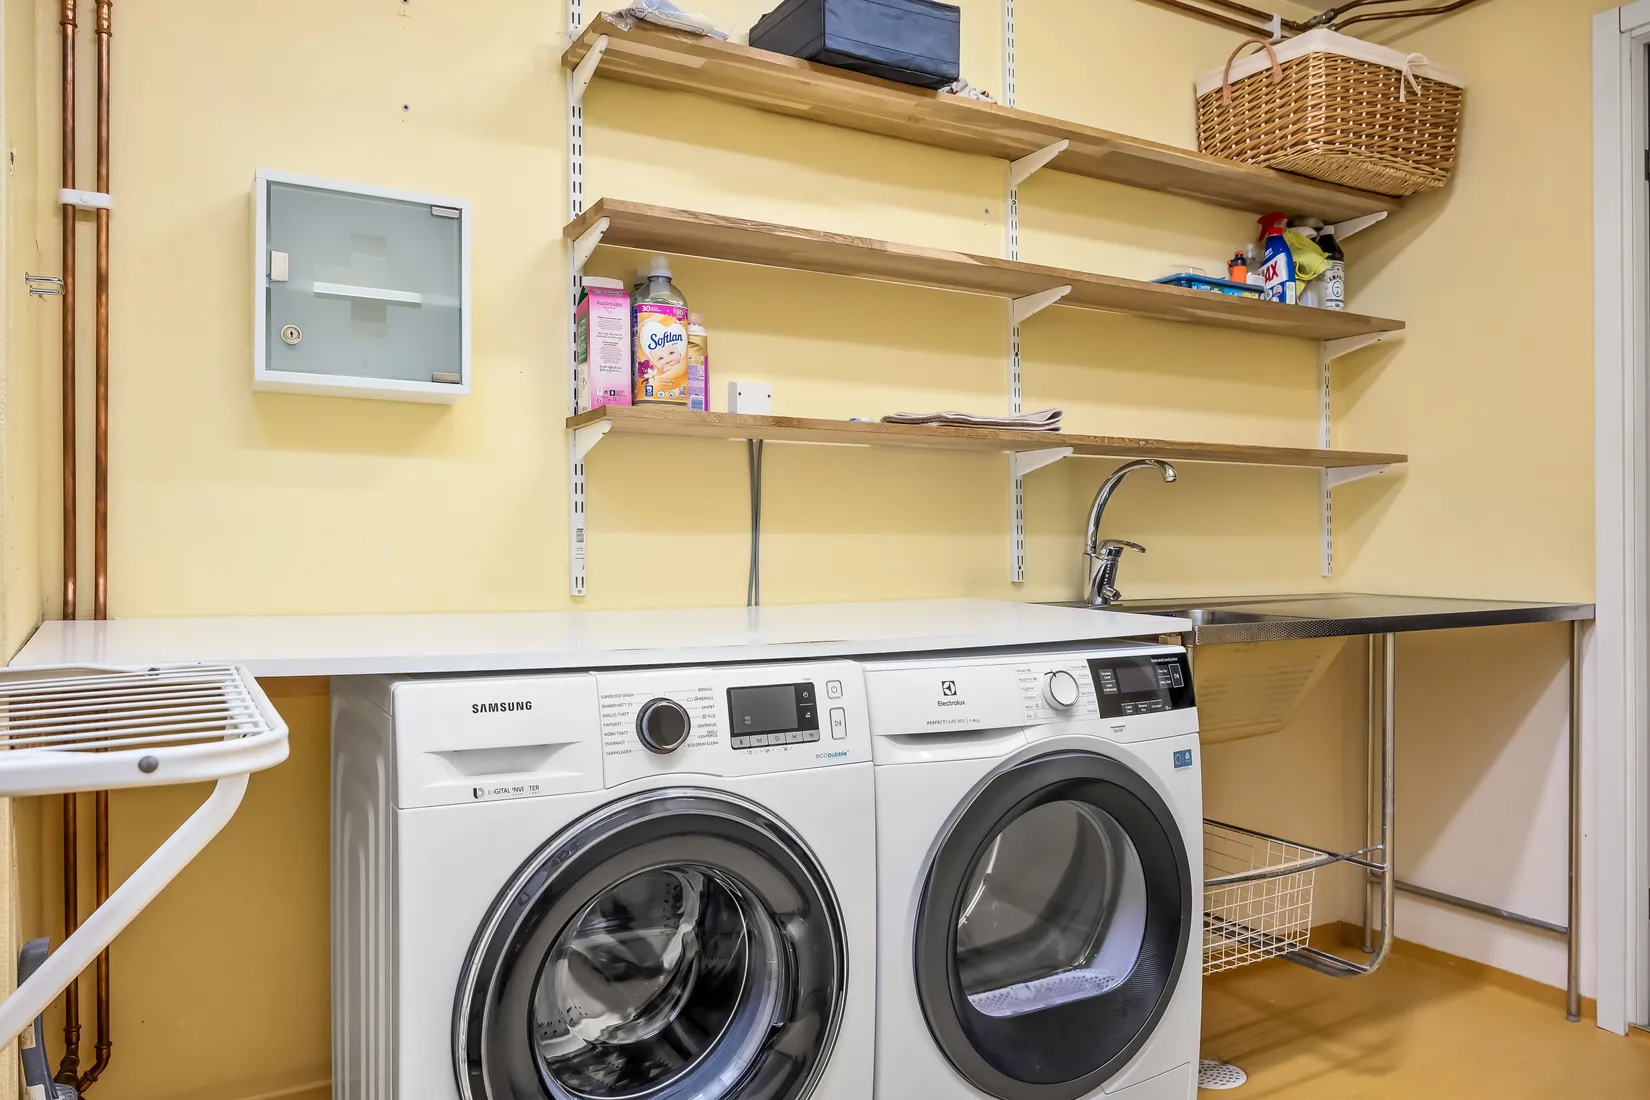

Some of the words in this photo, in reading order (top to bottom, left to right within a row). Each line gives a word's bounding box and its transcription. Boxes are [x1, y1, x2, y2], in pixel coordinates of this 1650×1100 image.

[648, 331, 683, 350] Softlan
[472, 701, 532, 714] SAMSUNG
[816, 751, 848, 759] ecobubble
